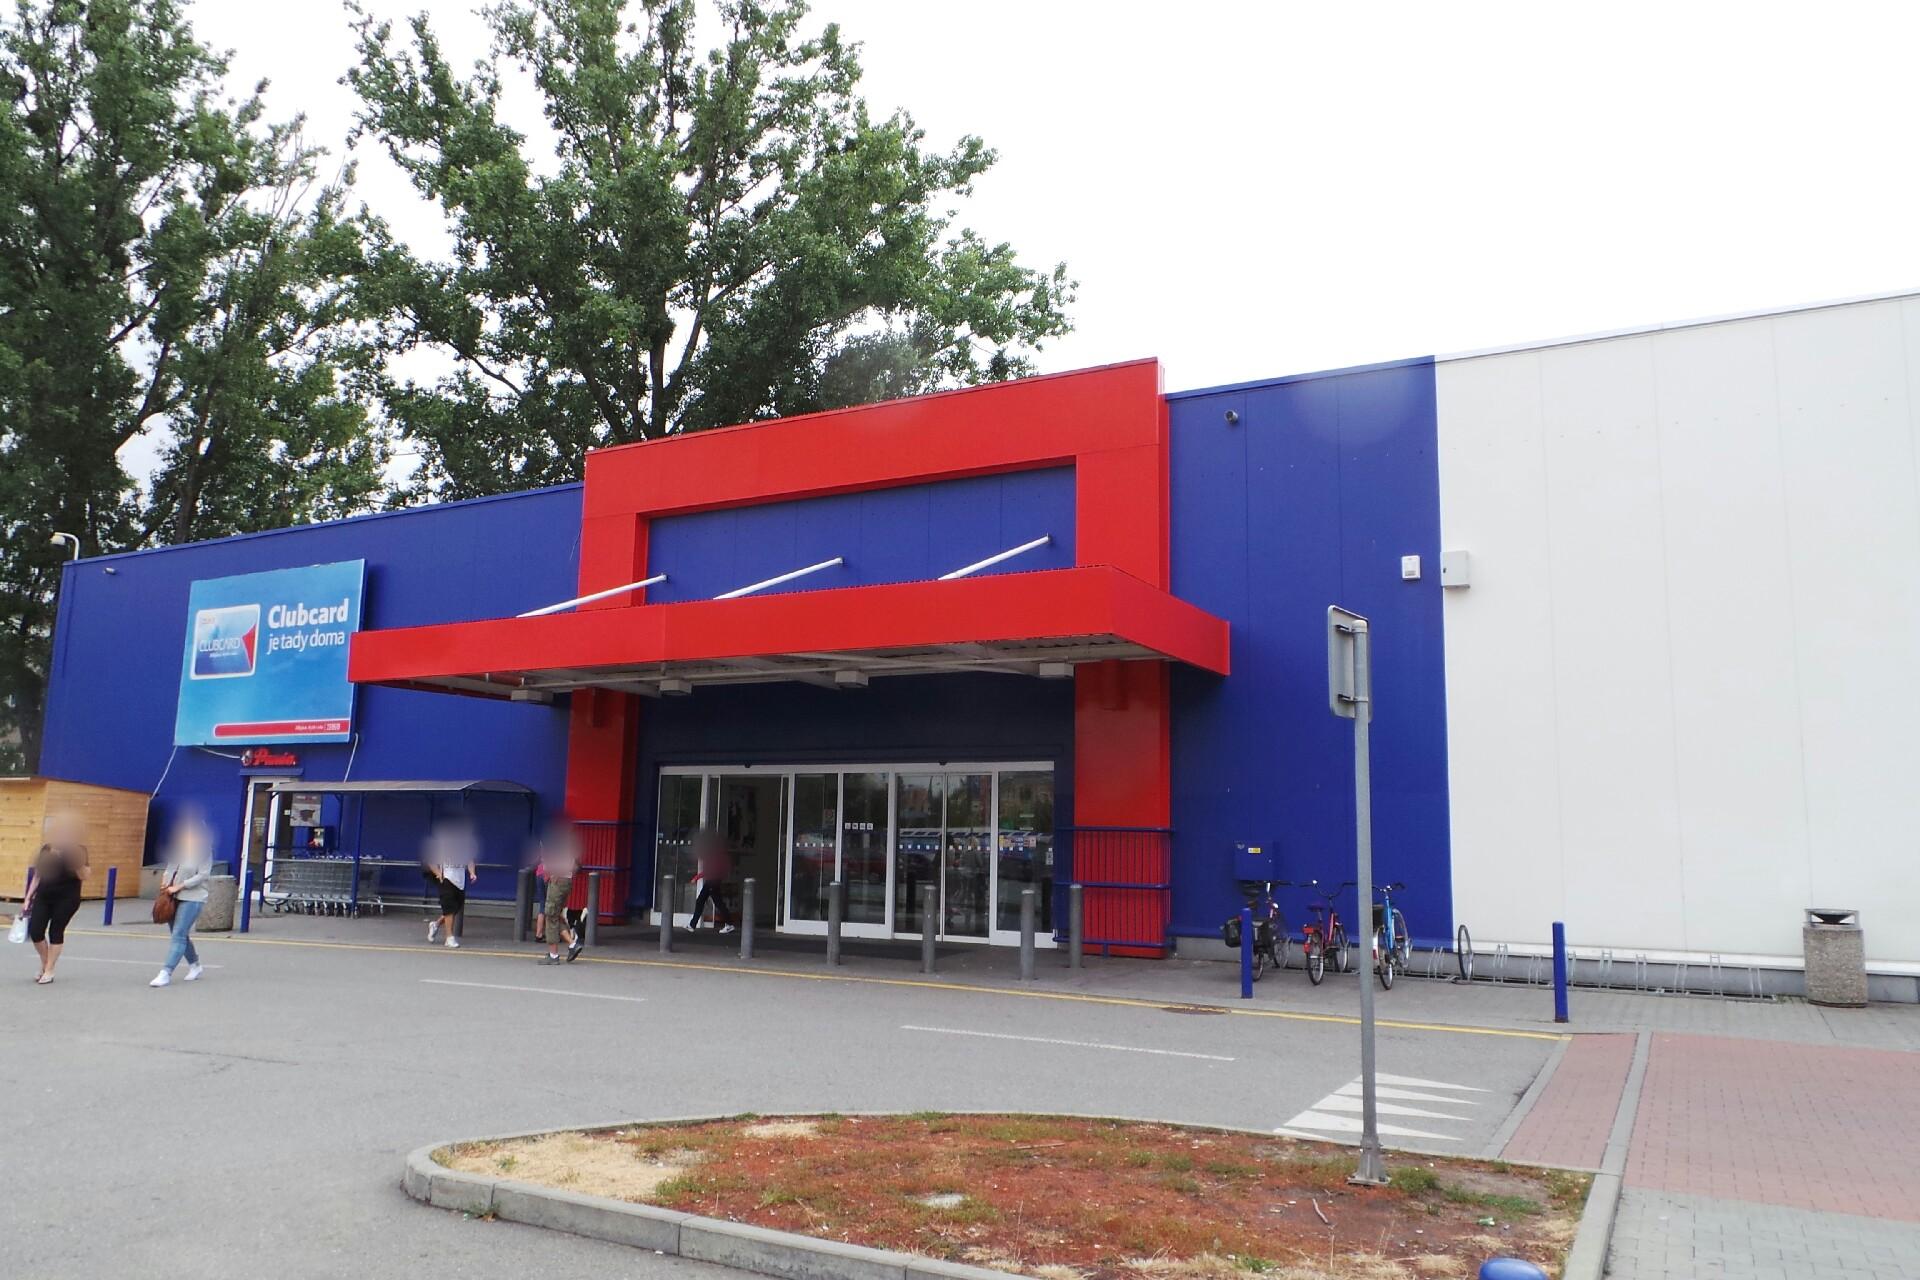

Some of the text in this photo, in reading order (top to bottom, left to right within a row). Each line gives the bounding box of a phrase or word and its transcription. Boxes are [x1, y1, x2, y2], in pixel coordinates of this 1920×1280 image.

[268, 598, 349, 629] Clubcard
[266, 628, 345, 655] je tady doma
